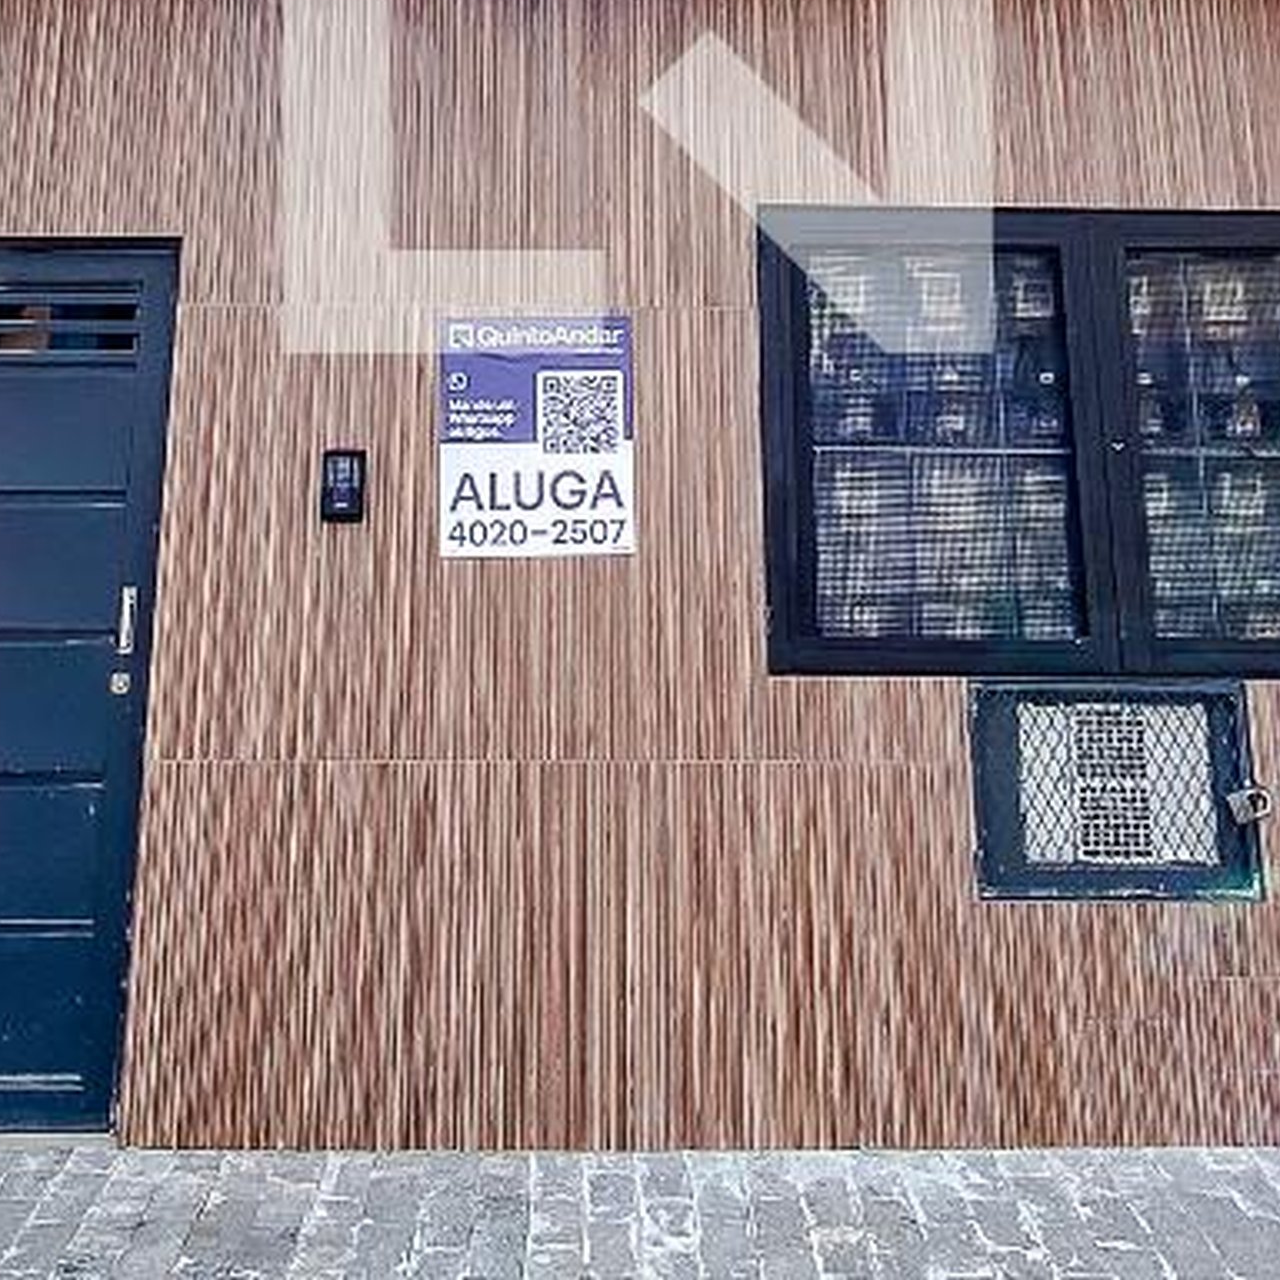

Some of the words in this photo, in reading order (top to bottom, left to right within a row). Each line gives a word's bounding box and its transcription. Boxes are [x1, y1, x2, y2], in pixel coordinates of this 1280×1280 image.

[476, 324, 625, 349] QuintoAndar
[449, 470, 625, 511] ALUGA
[448, 519, 627, 547] 4020-2507
